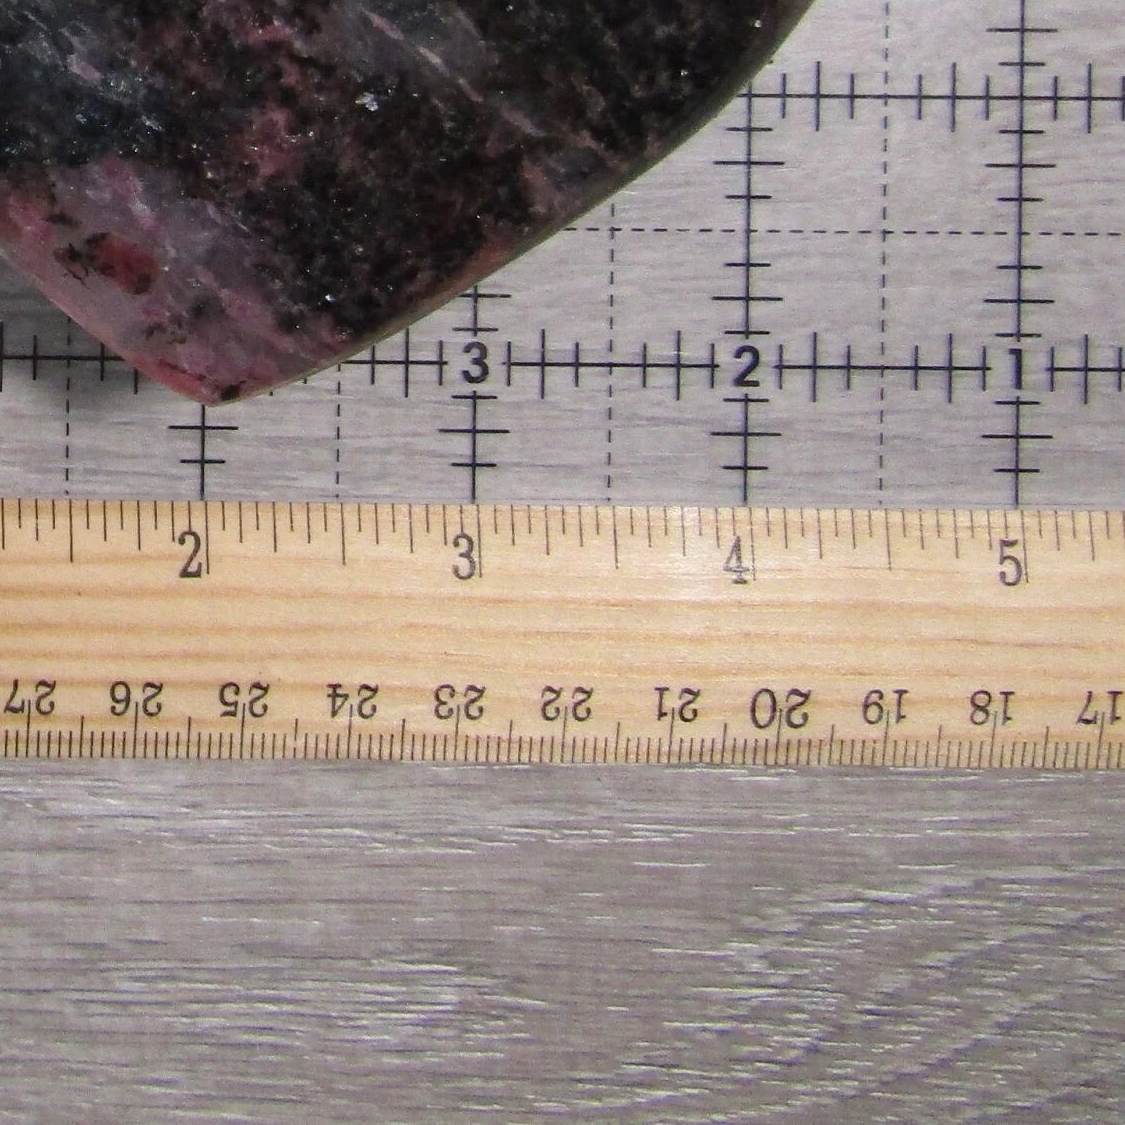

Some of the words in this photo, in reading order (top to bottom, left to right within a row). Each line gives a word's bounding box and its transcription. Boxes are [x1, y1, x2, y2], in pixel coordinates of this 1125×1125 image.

[461, 341, 490, 383] 3
[733, 345, 762, 387] 2
[1009, 348, 1024, 390] 1
[178, 530, 204, 579] 2
[453, 532, 477, 580] 3
[722, 535, 750, 584] 4
[998, 538, 1024, 586] 5
[5, 679, 57, 716] 27
[109, 680, 162, 718] 26
[219, 681, 270, 719] 25
[327, 683, 378, 720] 24
[434, 684, 486, 722] 23
[541, 685, 594, 723] 22
[654, 686, 702, 724] 21
[750, 686, 813, 729] 20
[862, 688, 909, 725] 19
[970, 689, 1015, 726] 18
